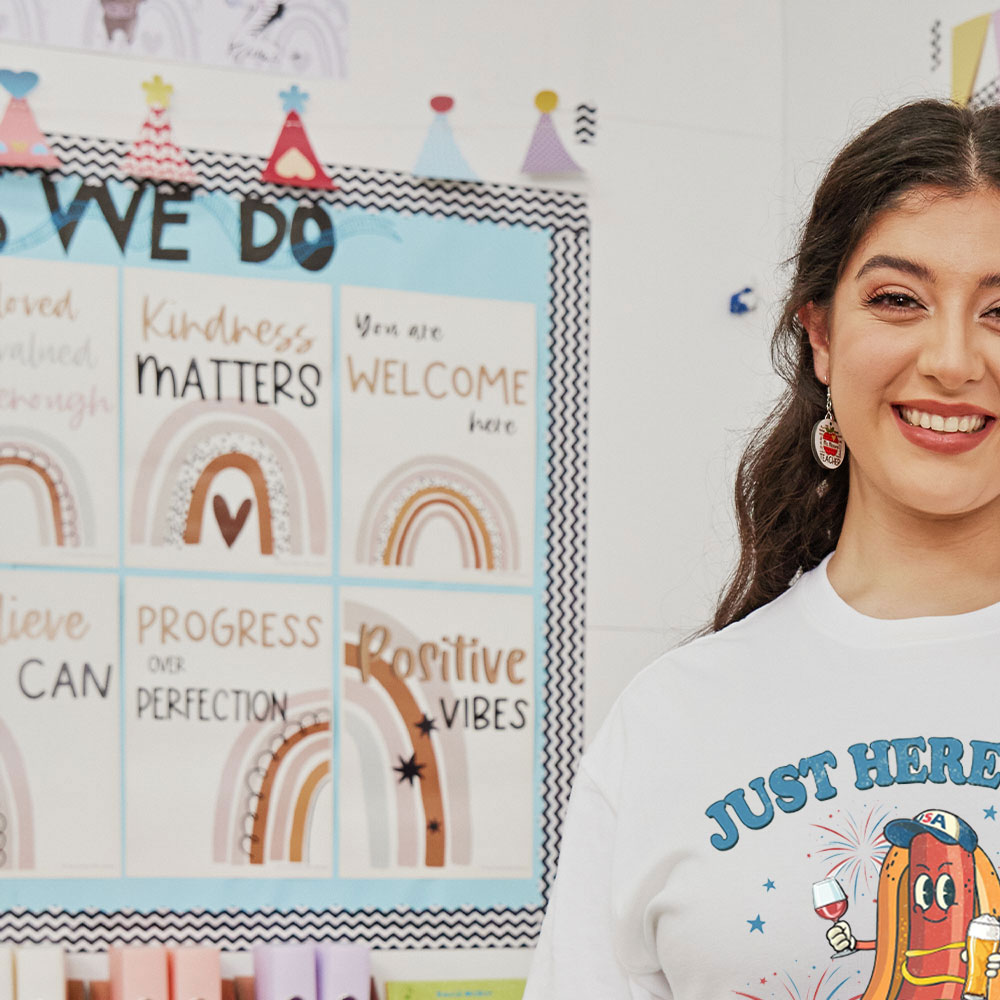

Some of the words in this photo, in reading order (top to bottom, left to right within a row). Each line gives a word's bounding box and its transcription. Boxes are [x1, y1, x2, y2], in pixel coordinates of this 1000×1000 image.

[41, 176, 194, 261] WE
[239, 194, 336, 272] DO
[142, 295, 317, 355] Kindness
[354, 313, 399, 339] You
[408, 324, 444, 341] are
[346, 355, 529, 406] WELCOME
[468, 412, 517, 435] here
[137, 604, 323, 648] PROGRESS
[147, 654, 185, 674] OVER
[359, 622, 527, 685] Positive
[18, 658, 113, 700] CAN
[137, 687, 288, 722] PERFECTION
[440, 696, 529, 731] VIBES
[705, 750, 838, 851] JUST
